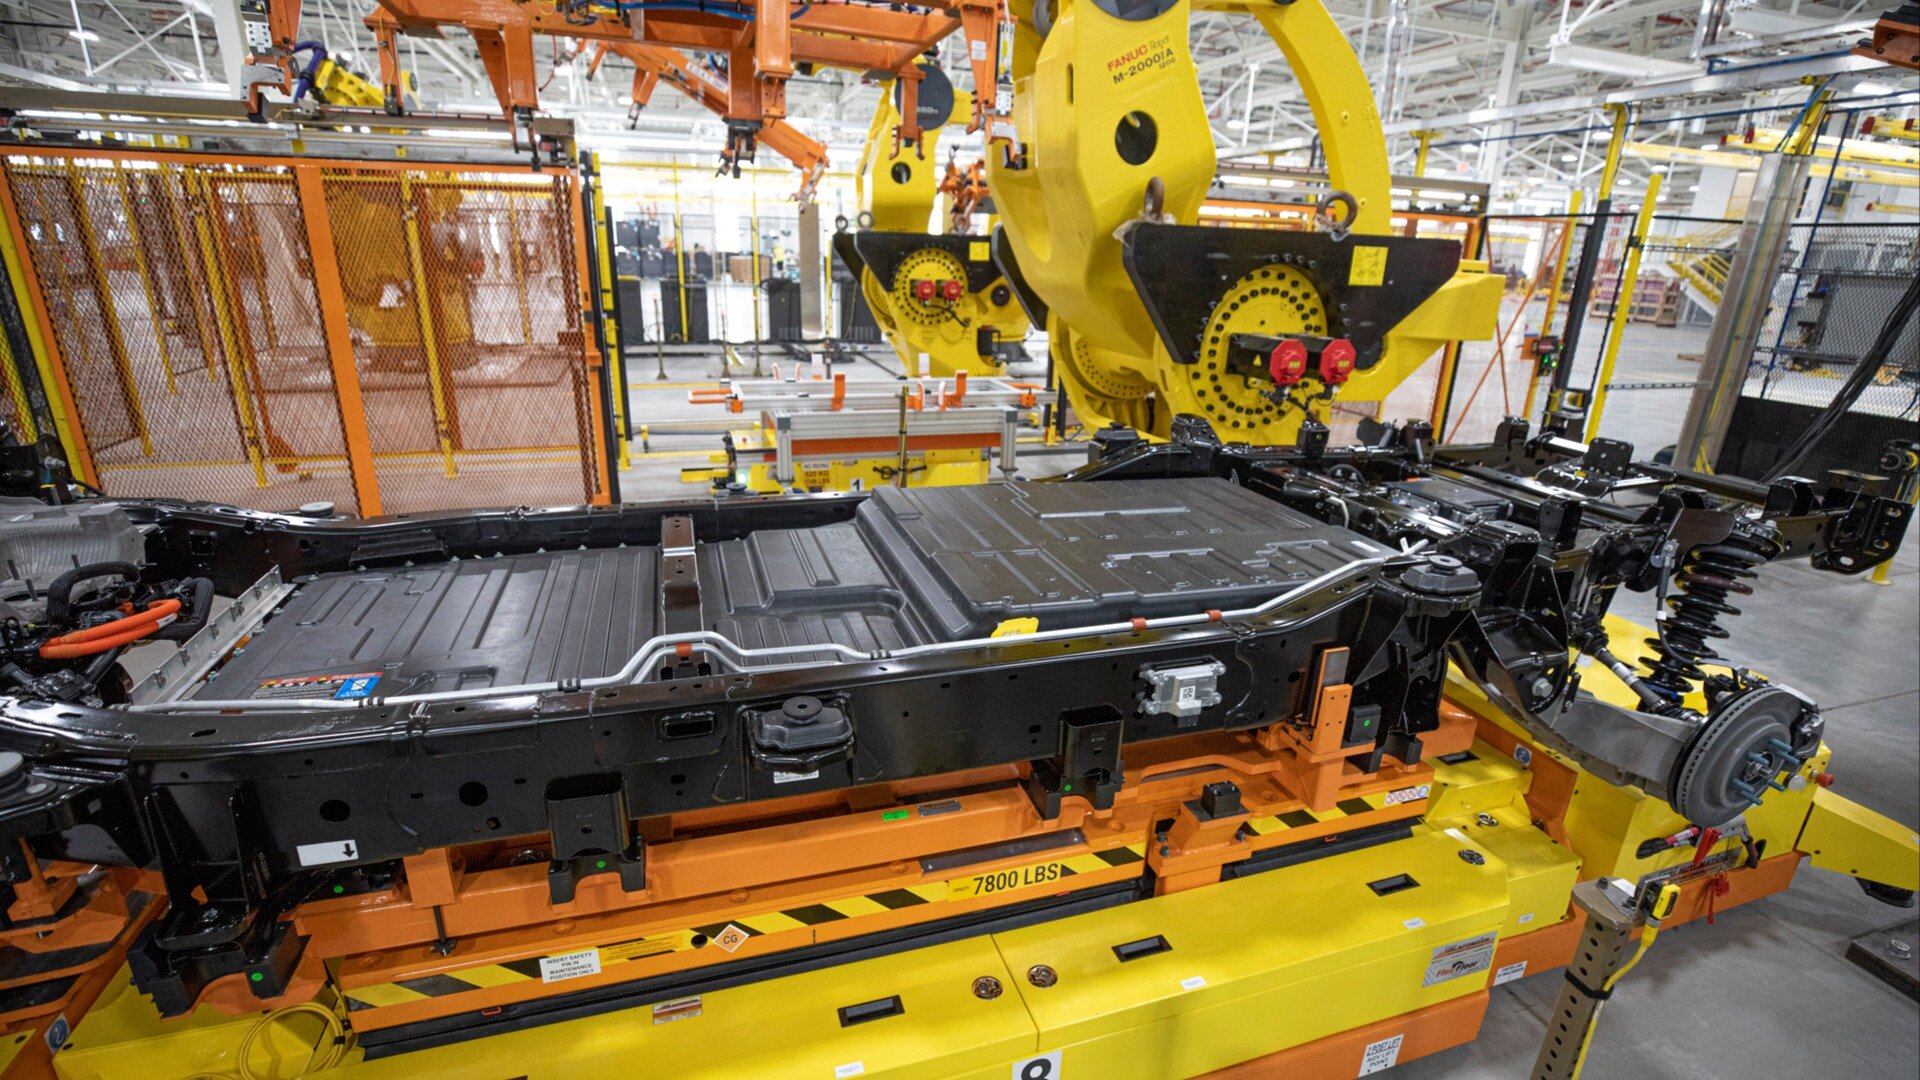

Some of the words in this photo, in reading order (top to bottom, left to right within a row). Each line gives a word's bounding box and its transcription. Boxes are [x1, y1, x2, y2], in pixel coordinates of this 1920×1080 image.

[1107, 44, 1148, 73] FANUC
[853, 478, 860, 491] 1
[973, 870, 1018, 895] 7800
[1024, 863, 1058, 885] LBS
[723, 934, 738, 944] CG
[546, 956, 569, 964] INSERT
[570, 951, 593, 960] SAFETY
[550, 963, 593, 975] MAINTENANCE
[550, 972, 578, 980] POSITION
[578, 968, 594, 976] ONLY
[1371, 1041, 1388, 1055] POST
[1387, 1037, 1401, 1050] LIFT
[1370, 1058, 1389, 1067] POINT
